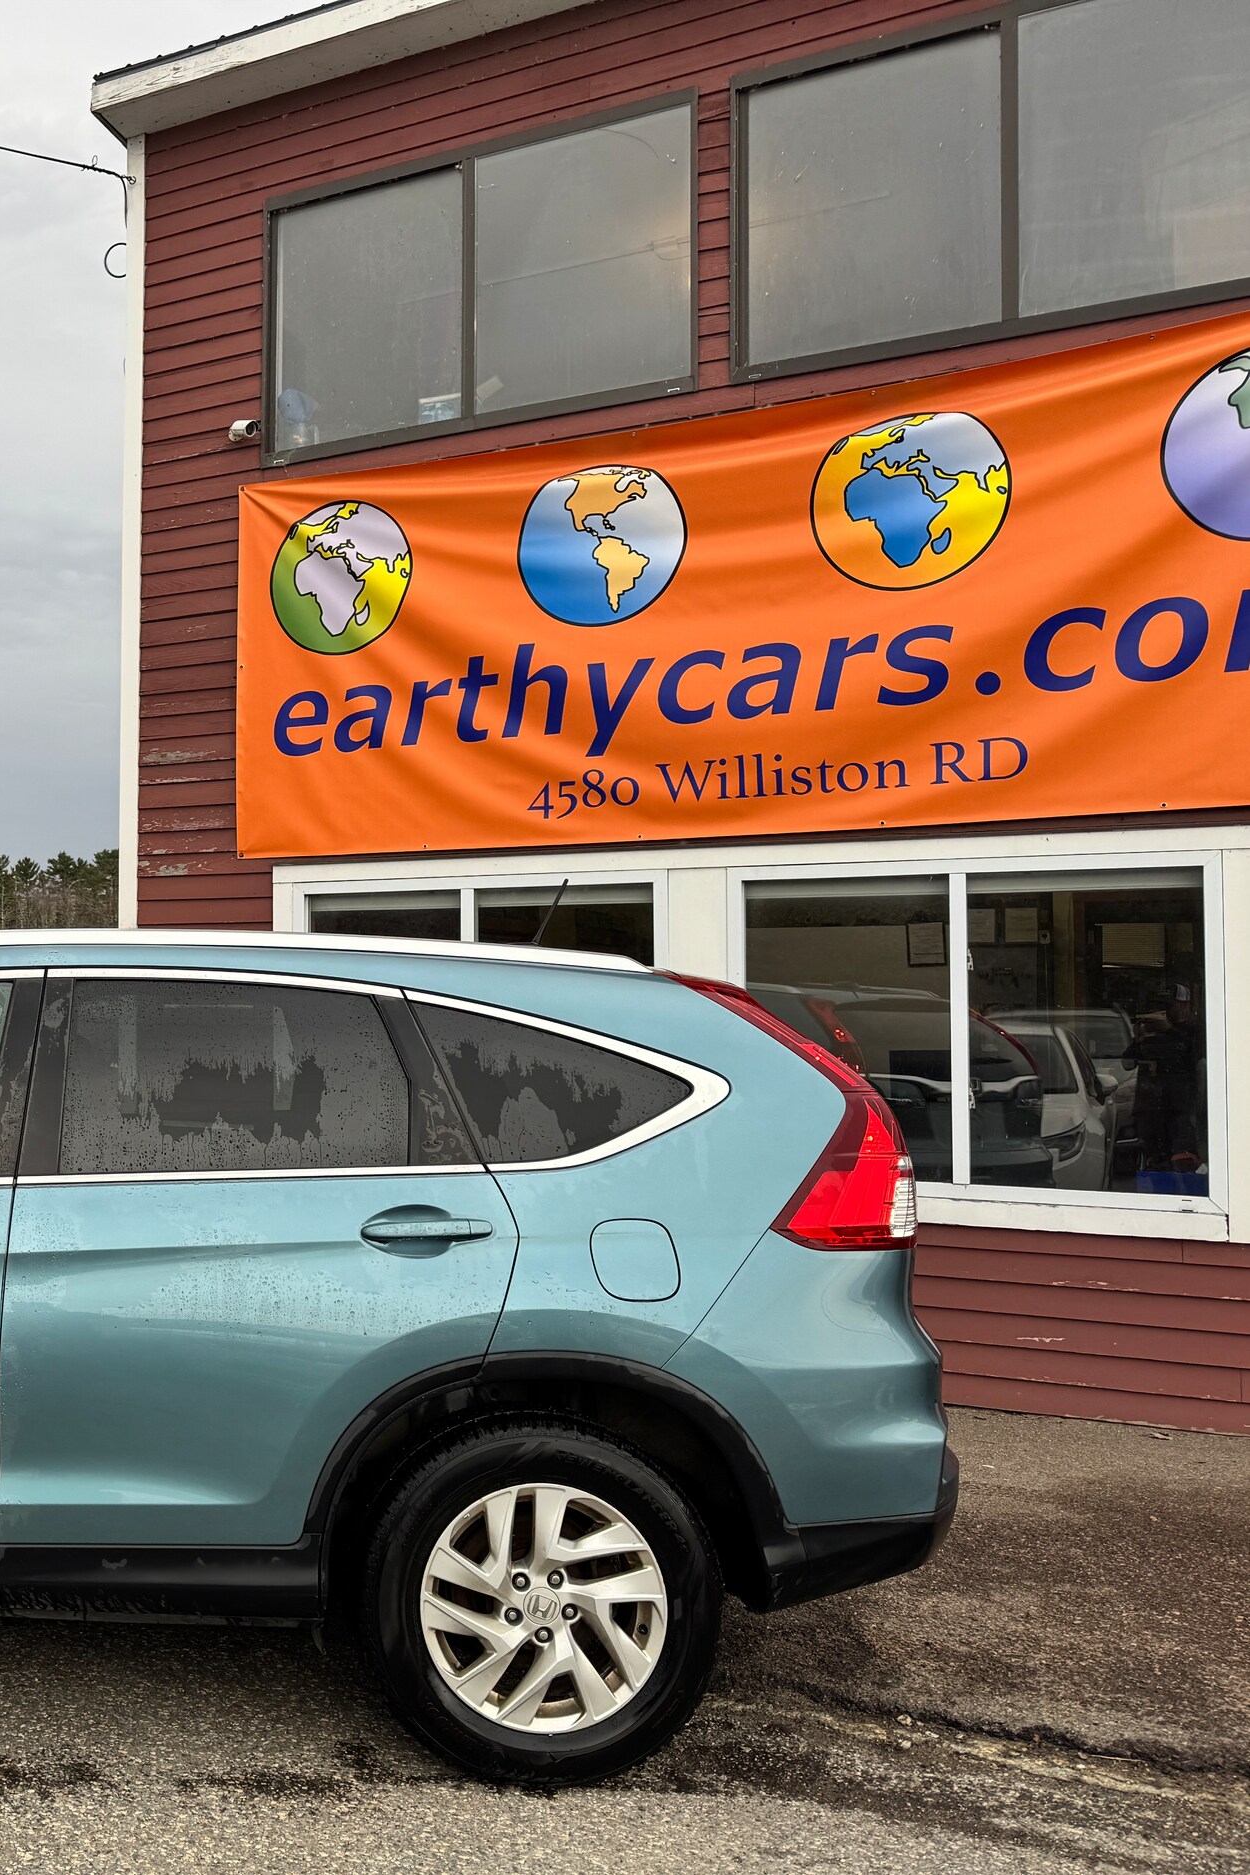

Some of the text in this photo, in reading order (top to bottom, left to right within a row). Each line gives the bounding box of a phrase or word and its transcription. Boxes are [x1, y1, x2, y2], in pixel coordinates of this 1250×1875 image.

[527, 736, 1028, 819] 4580 Williston RD
